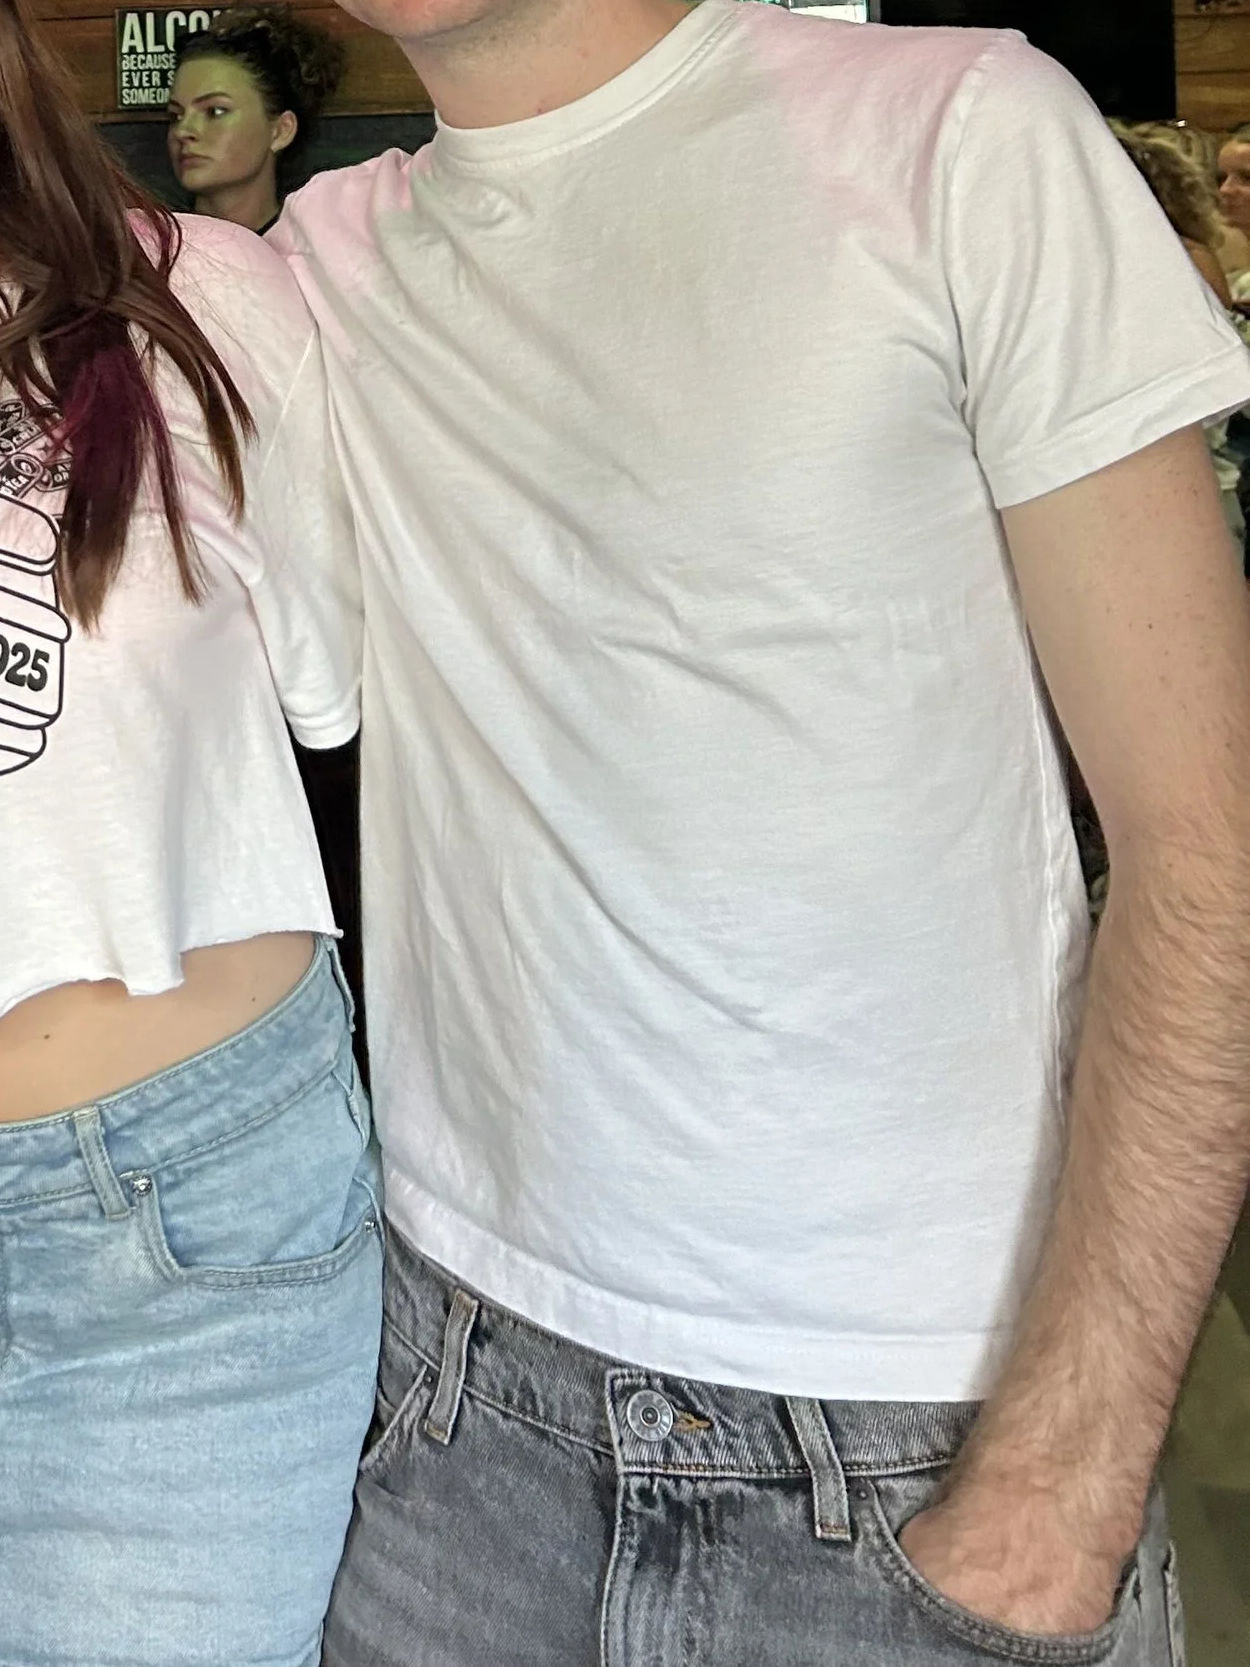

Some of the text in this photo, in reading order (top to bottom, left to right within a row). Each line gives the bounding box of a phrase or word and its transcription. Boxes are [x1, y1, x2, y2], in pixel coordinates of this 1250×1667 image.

[122, 10, 221, 53] ALCO
[122, 53, 176, 70] BECAUSE
[122, 70, 161, 87] EVER
